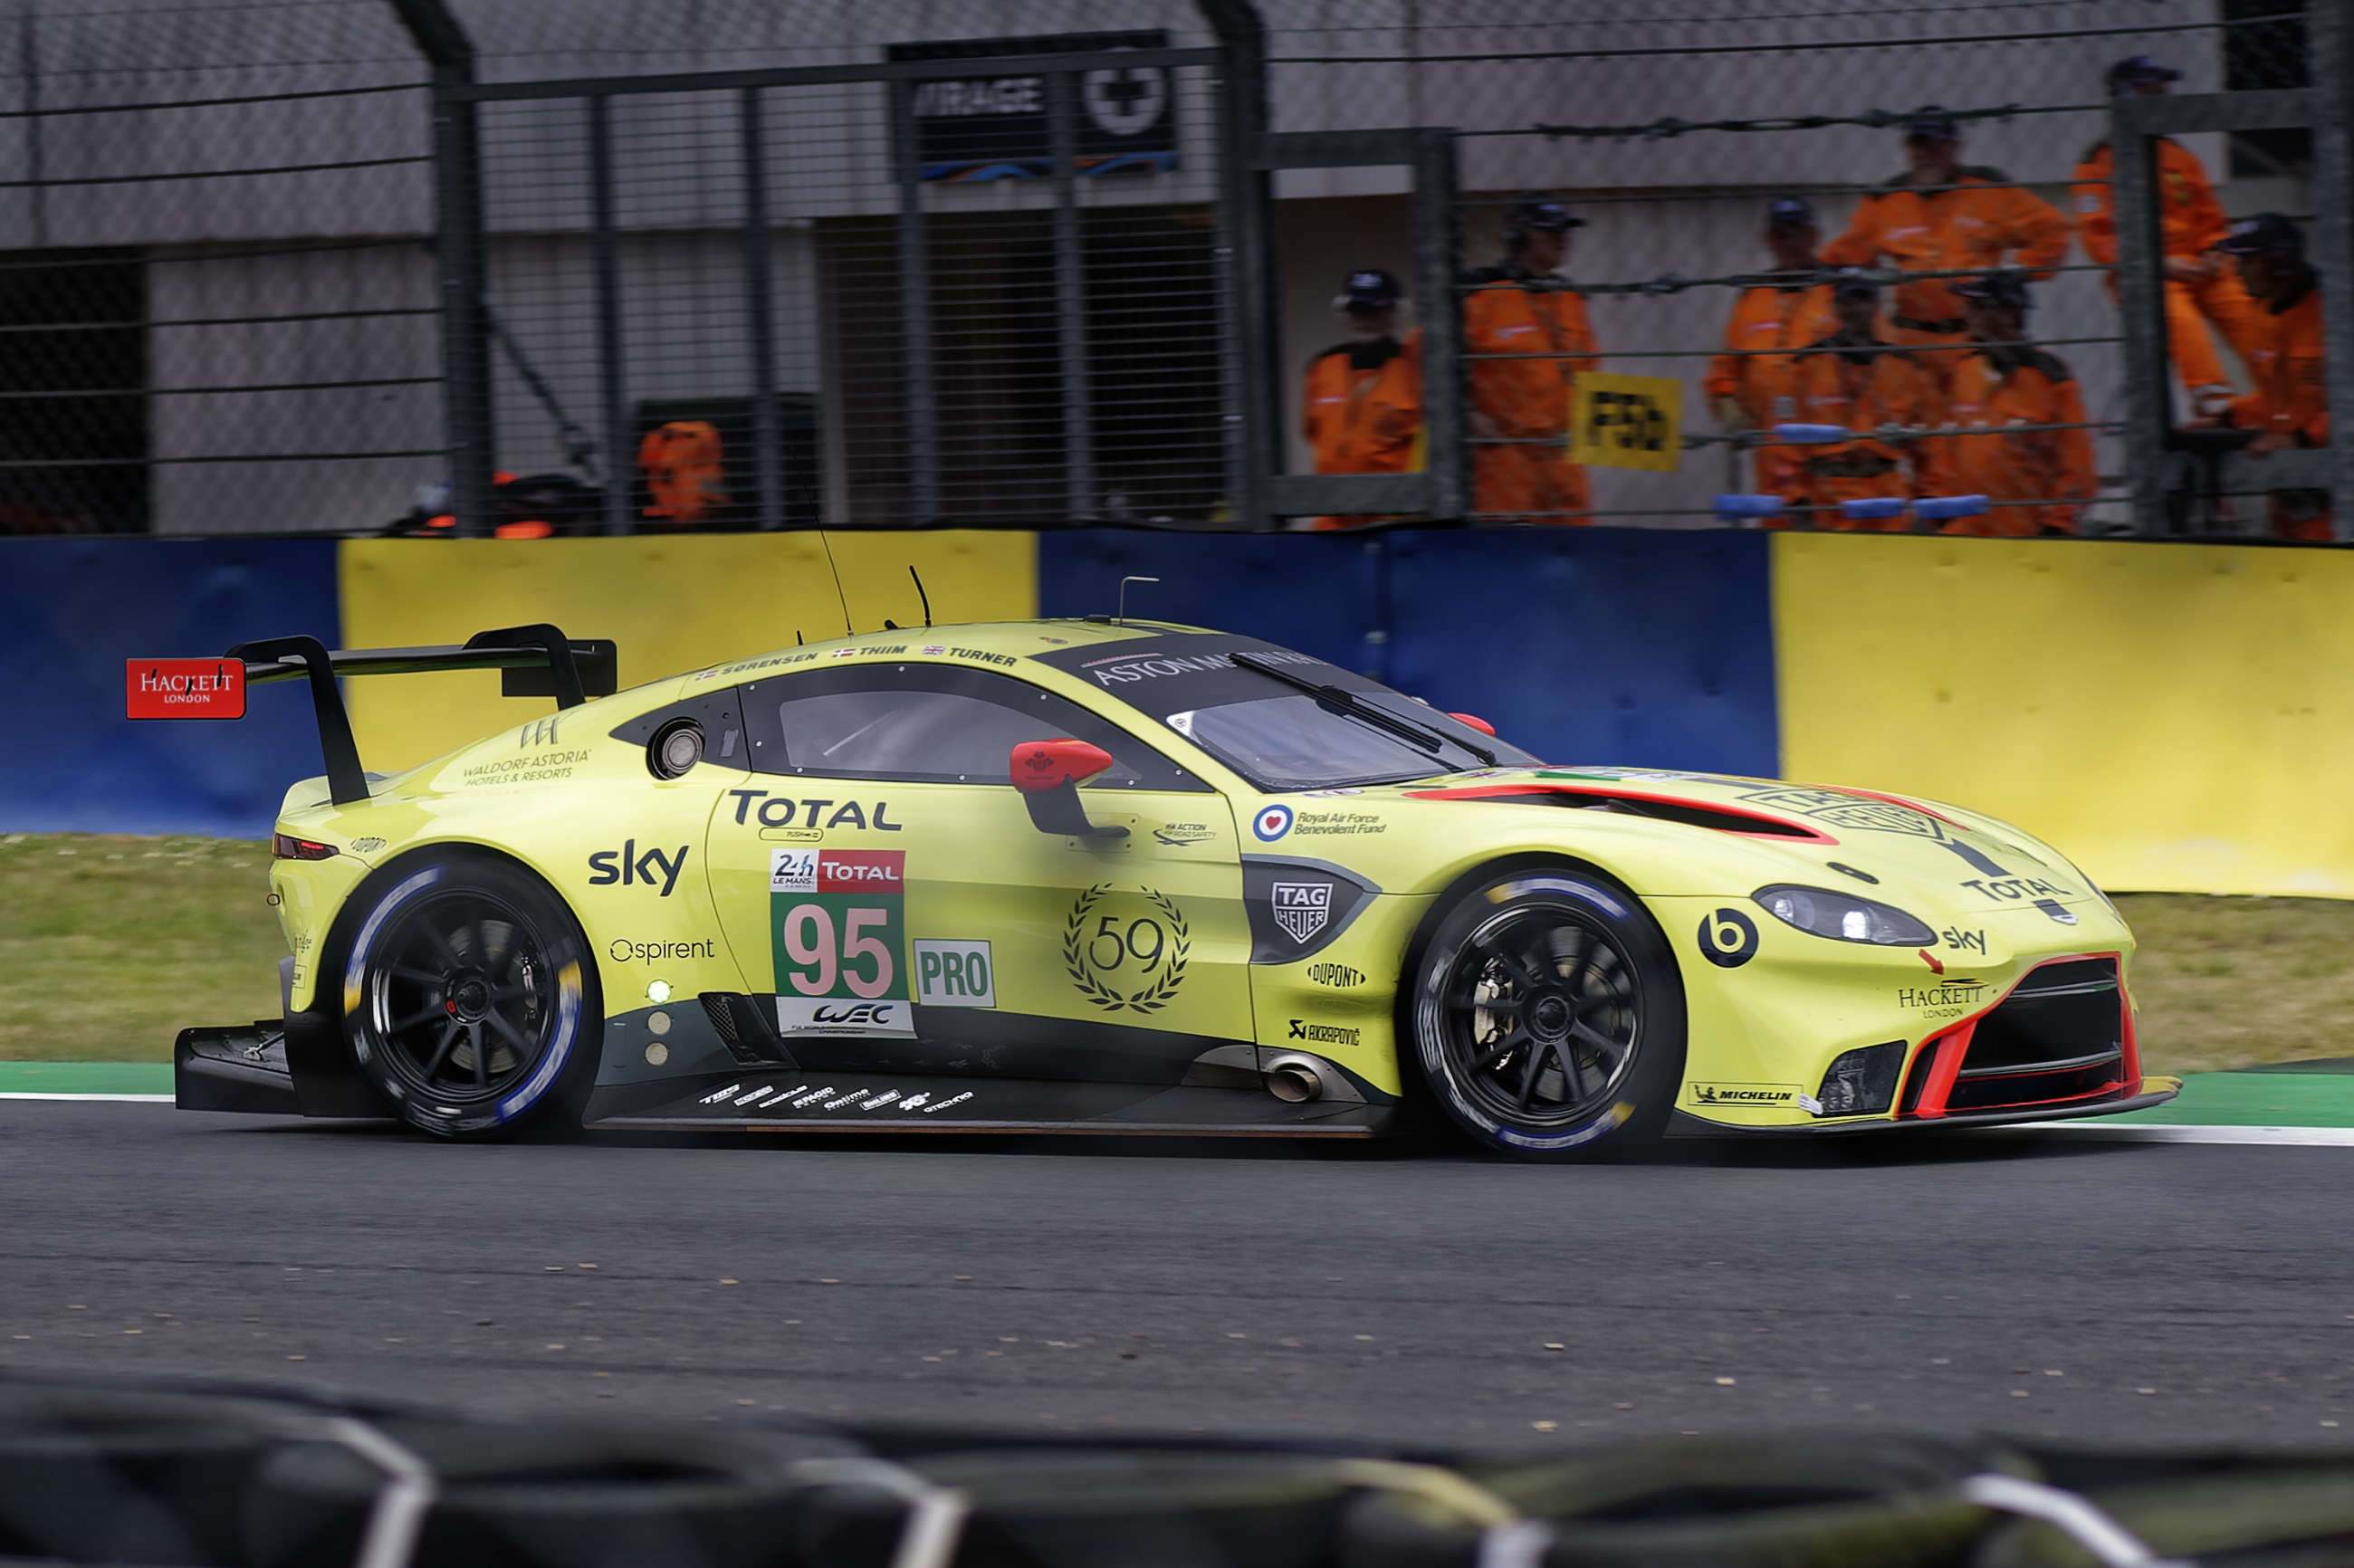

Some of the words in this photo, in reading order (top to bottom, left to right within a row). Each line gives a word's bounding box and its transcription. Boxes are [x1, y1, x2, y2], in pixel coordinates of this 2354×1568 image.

[860, 645, 907, 655] THIIM
[950, 647, 1017, 667] TURNER
[140, 673, 234, 692] HACKETT
[1093, 658, 1204, 686] ASTON
[164, 694, 210, 703] LONDON
[464, 758, 531, 777] WALDORF
[531, 750, 589, 767] ASTORIA
[464, 774, 508, 786] HOTELS
[511, 773, 519, 782] &
[522, 768, 572, 781] RESORTS
[729, 790, 903, 831] TOTAL
[1298, 812, 1328, 823] Royal
[1329, 813, 1346, 823] Air
[1347, 814, 1379, 823] Force
[1294, 824, 1355, 835] Benevolent
[1357, 824, 1386, 834] Fund
[588, 838, 689, 897] sky
[821, 862, 899, 881] TOTAL
[1278, 888, 1325, 905] TAG
[1960, 879, 2073, 902] TOTAL
[1278, 911, 1325, 939] HEUER
[1089, 916, 1163, 973] 59
[1942, 926, 1986, 955] sky
[635, 938, 715, 965] spirent
[784, 904, 894, 999] 95
[920, 951, 988, 997] PRO
[1313, 963, 1359, 988] DUPONT
[1899, 987, 1982, 1008] HACKETT
[813, 1004, 894, 1024] WEC
[1923, 1008, 1963, 1018] LONDON
[1719, 1090, 1793, 1101] MICHELIN
